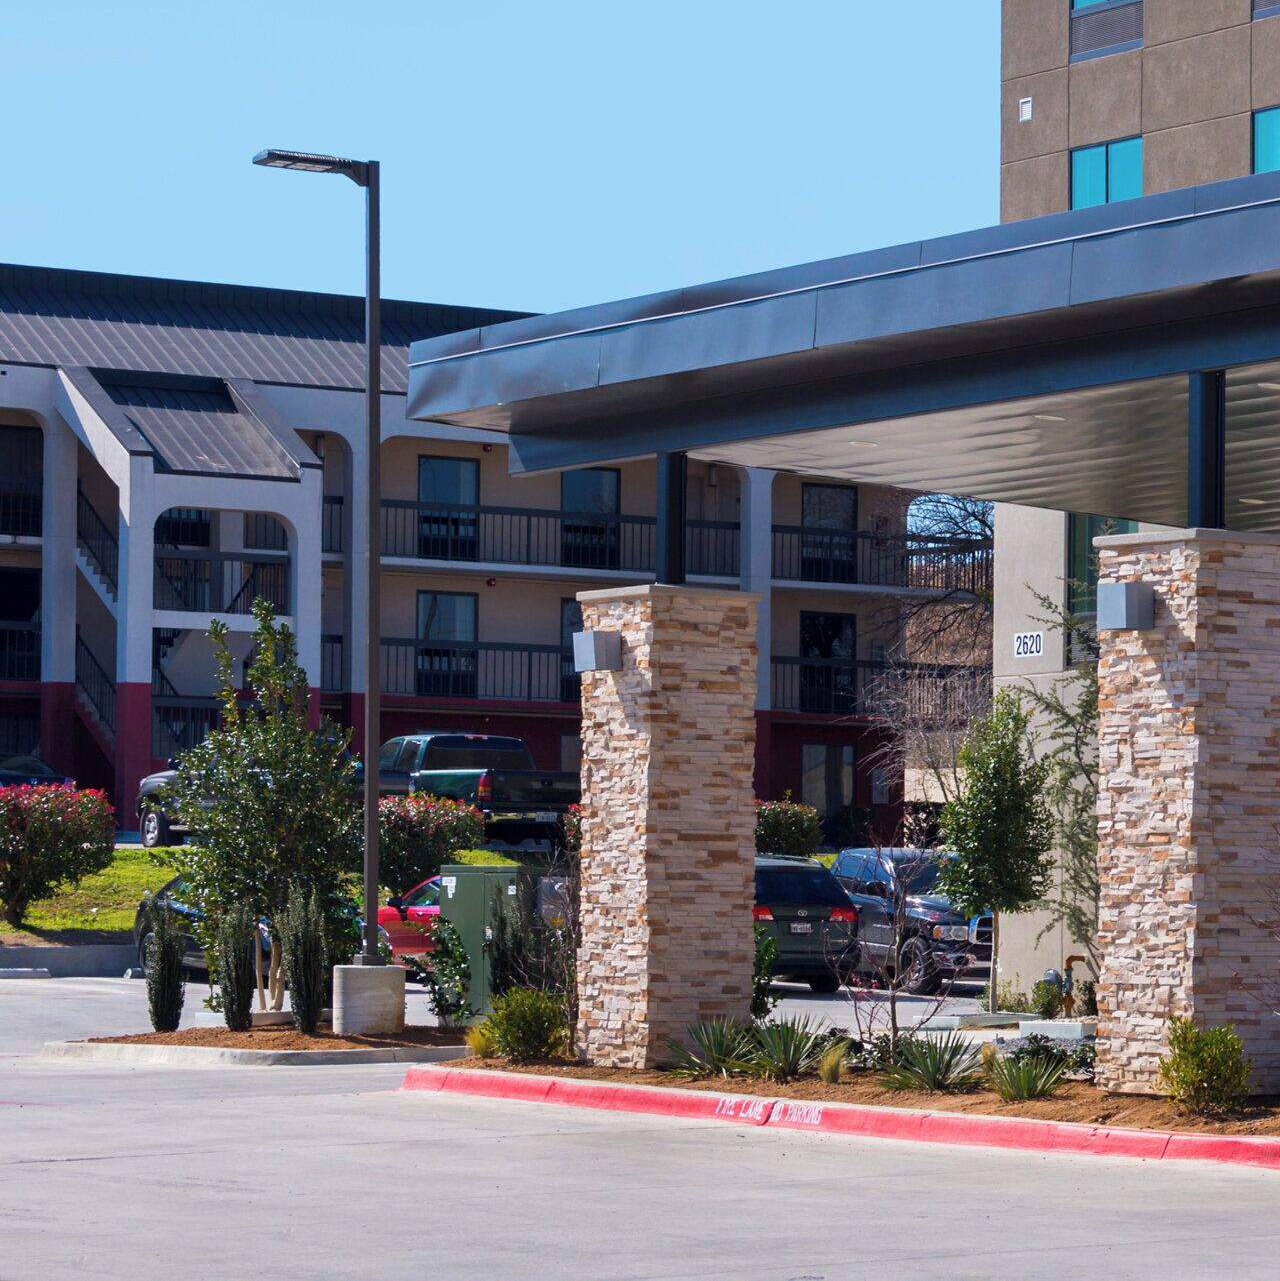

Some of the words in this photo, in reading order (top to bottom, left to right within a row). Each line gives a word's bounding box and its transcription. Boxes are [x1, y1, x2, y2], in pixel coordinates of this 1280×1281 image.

[1016, 633, 1042, 655] 2620
[739, 1099, 768, 1119] LANE
[785, 1104, 823, 1124] PARKING
